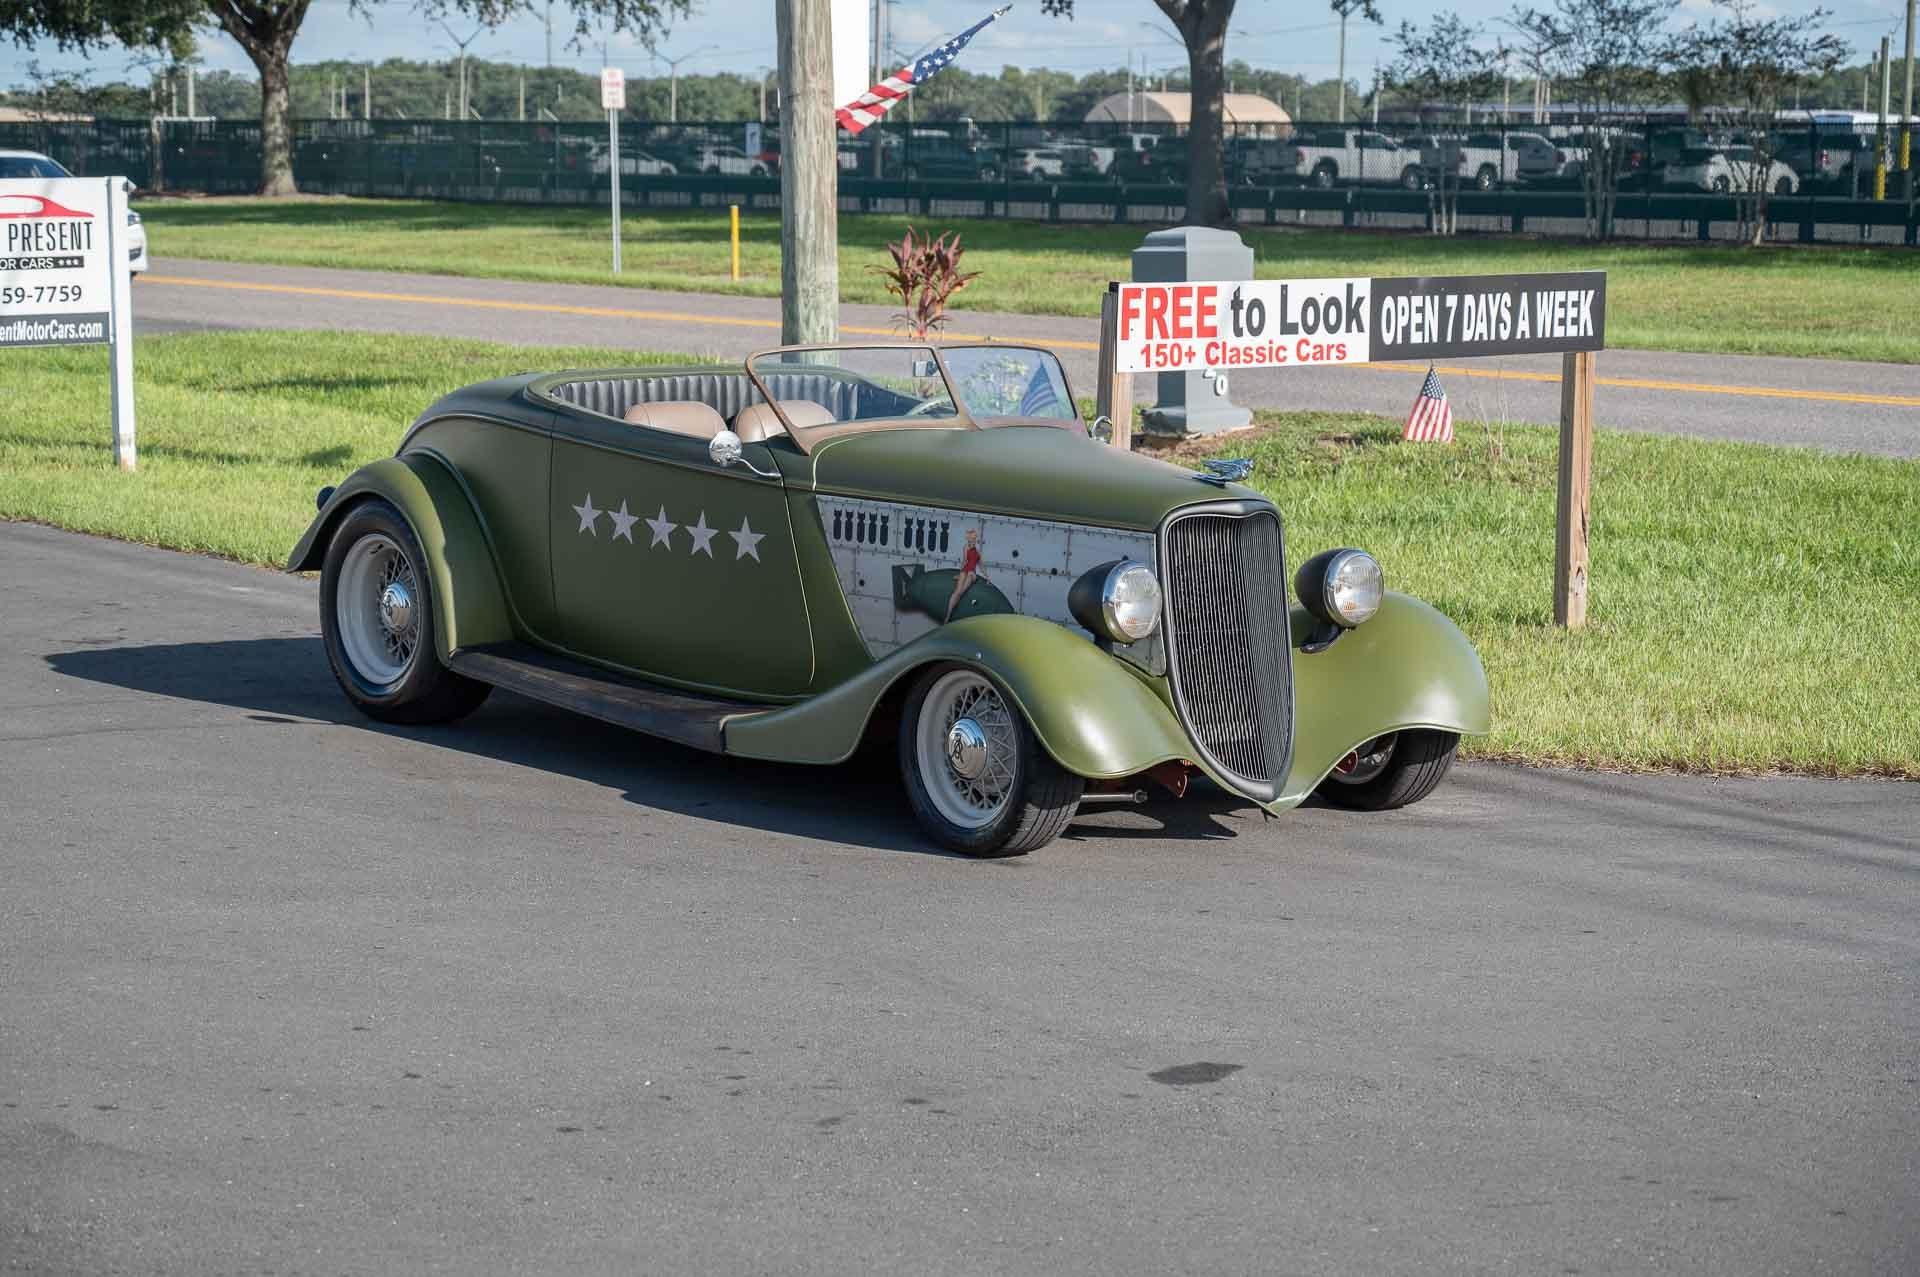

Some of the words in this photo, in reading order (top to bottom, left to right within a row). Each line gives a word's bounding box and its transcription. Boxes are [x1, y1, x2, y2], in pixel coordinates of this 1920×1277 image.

[8, 221, 93, 252] PRESENT
[19, 256, 55, 270] CARS
[2, 285, 82, 304] 59-7759
[1120, 286, 1218, 341] FREE
[1230, 286, 1266, 338] to
[1280, 283, 1366, 336] Look
[1381, 294, 1439, 345] OPEN
[1445, 295, 1458, 342] 7
[1462, 292, 1512, 342] DAYS
[1516, 292, 1531, 339] A
[1536, 290, 1595, 338] WEEK
[1141, 342, 1197, 368] 150+
[1205, 339, 1288, 366] Classic
[1296, 338, 1348, 362] Cars
